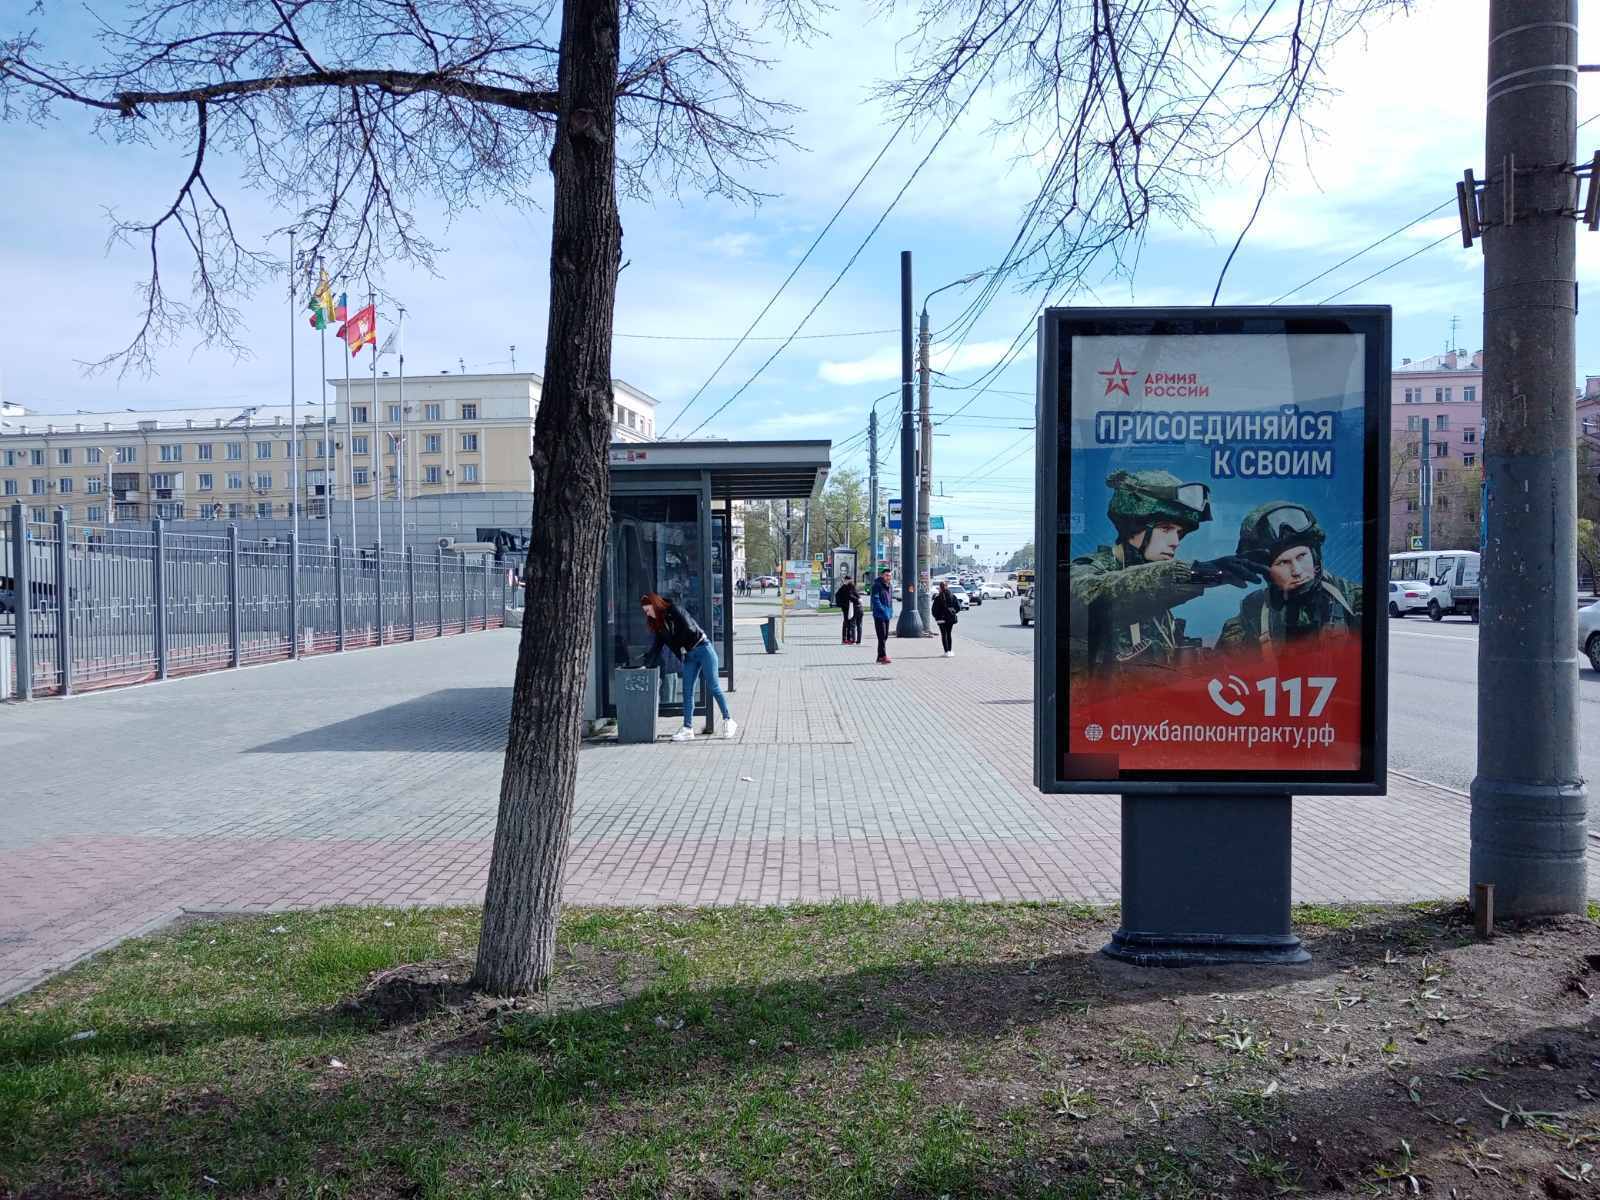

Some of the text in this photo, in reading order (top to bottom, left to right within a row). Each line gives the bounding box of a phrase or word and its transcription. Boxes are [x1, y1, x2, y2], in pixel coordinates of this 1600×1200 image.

[1145, 373, 1197, 384] АРМИЯ
[1145, 386, 1209, 397] РОССИИ
[1099, 408, 1333, 445] ПРИСОЕДИНЯЙСЯ
[1214, 450, 1332, 476] К СВОИМ
[1255, 676, 1338, 717] 117
[1110, 719, 1336, 749] службапоконтракту.рф
